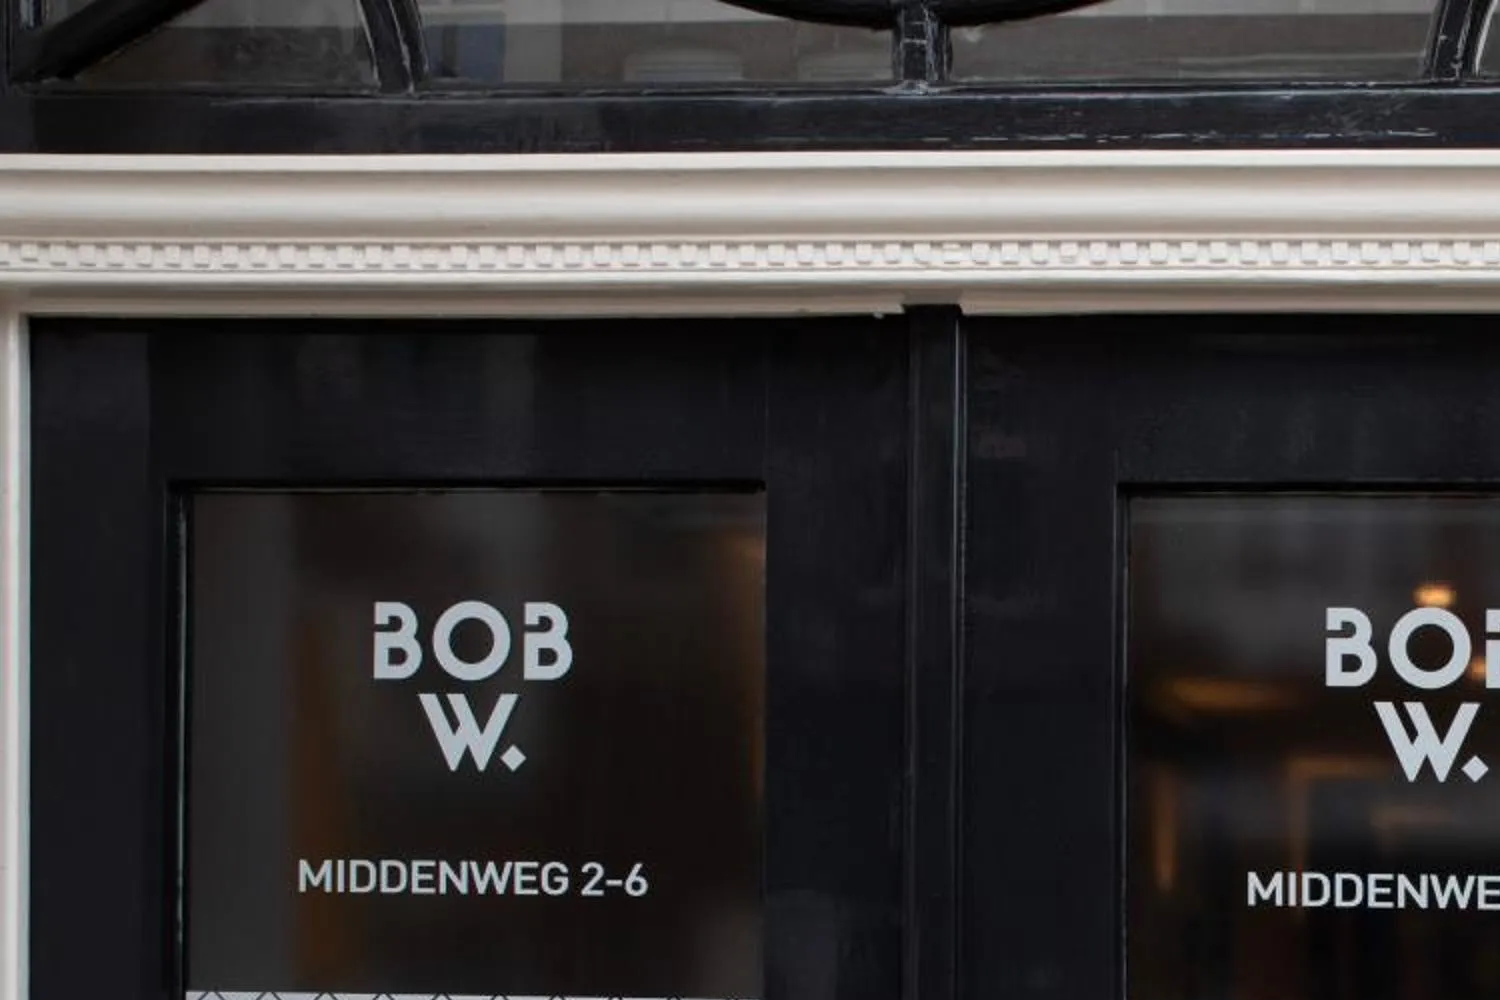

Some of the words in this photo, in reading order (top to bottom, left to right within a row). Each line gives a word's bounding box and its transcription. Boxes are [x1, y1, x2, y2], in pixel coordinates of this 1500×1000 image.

[374, 600, 573, 681] BOB
[419, 693, 527, 772] W.
[1373, 701, 1489, 783] W.
[298, 859, 570, 896] MIDDENWEG
[580, 862, 649, 897] 2-6
